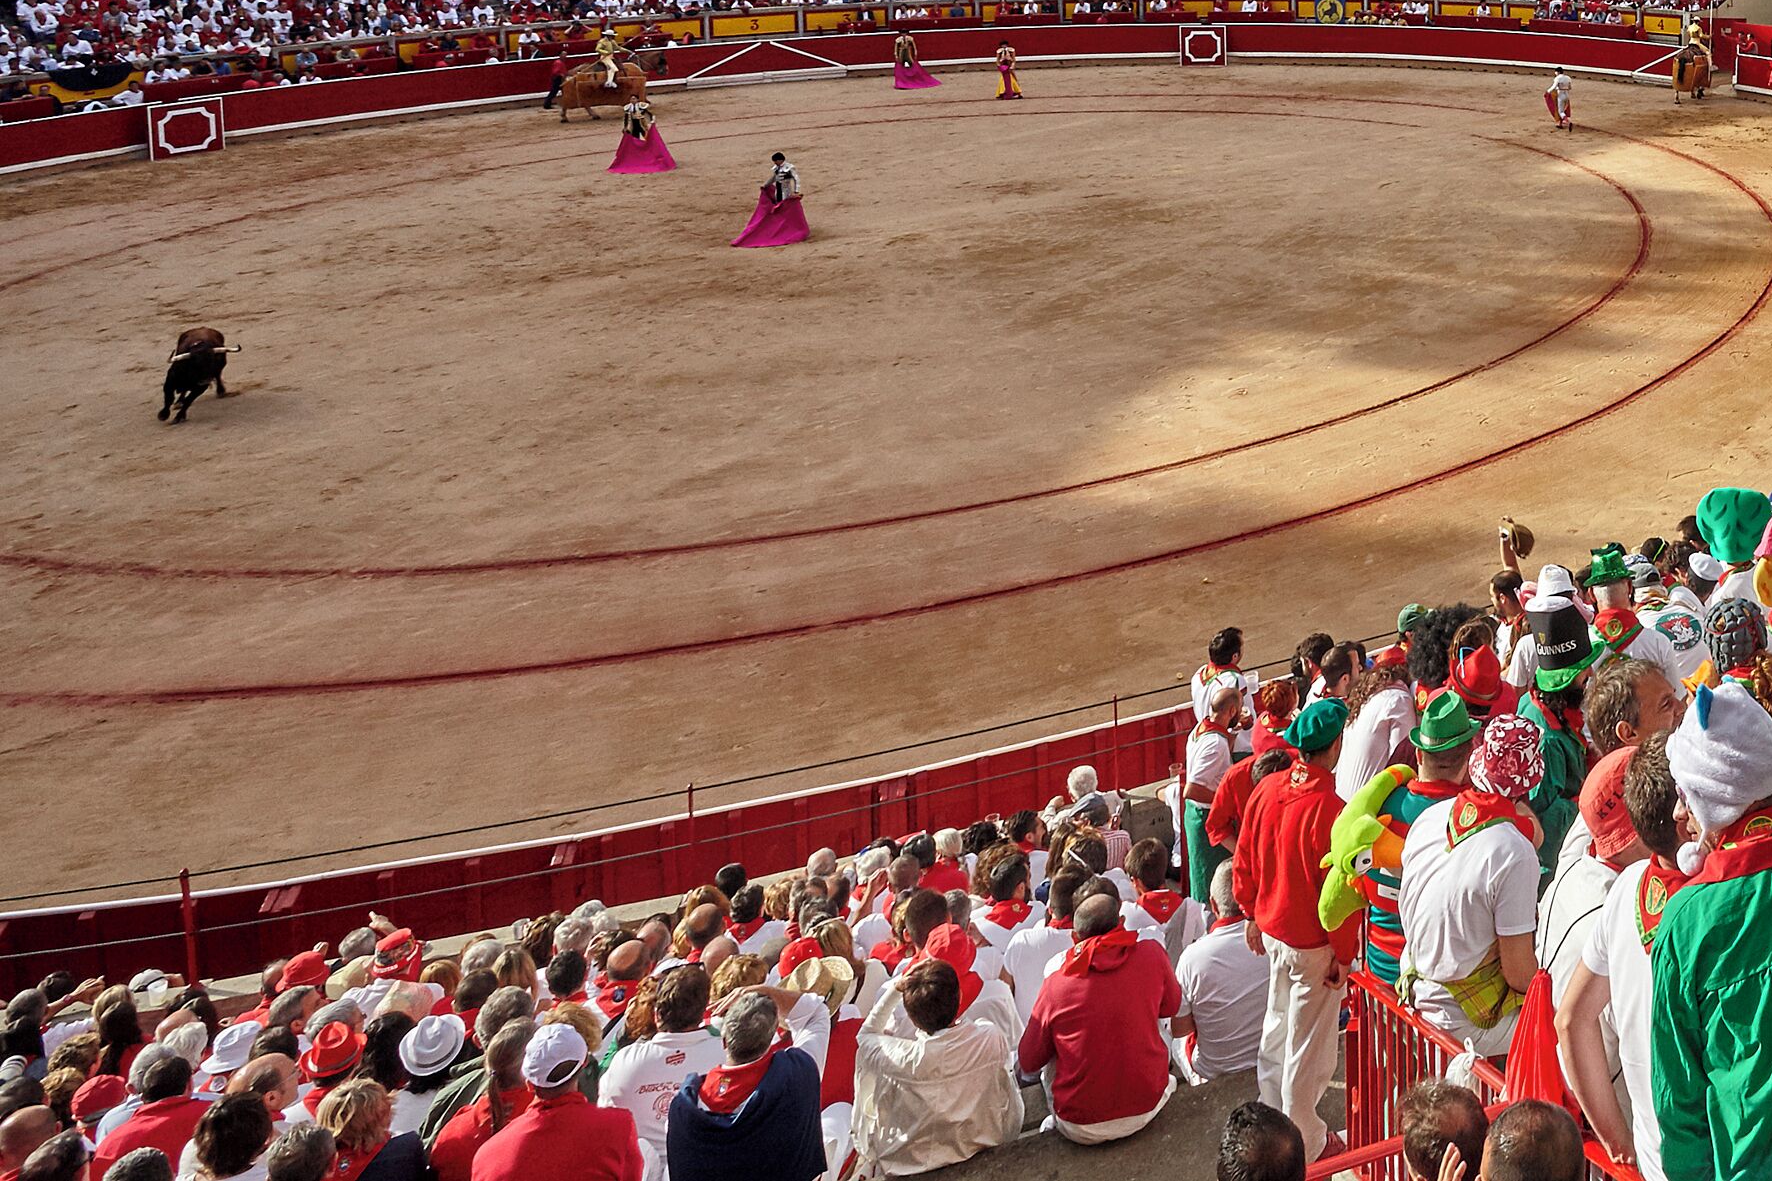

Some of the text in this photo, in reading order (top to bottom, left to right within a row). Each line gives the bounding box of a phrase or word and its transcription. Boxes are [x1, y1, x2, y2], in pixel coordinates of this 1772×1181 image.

[750, 19, 759, 30] 3
[1657, 19, 1664, 30] 4
[1537, 640, 1577, 655] GUINNESS
[1596, 781, 1625, 819] KEL
